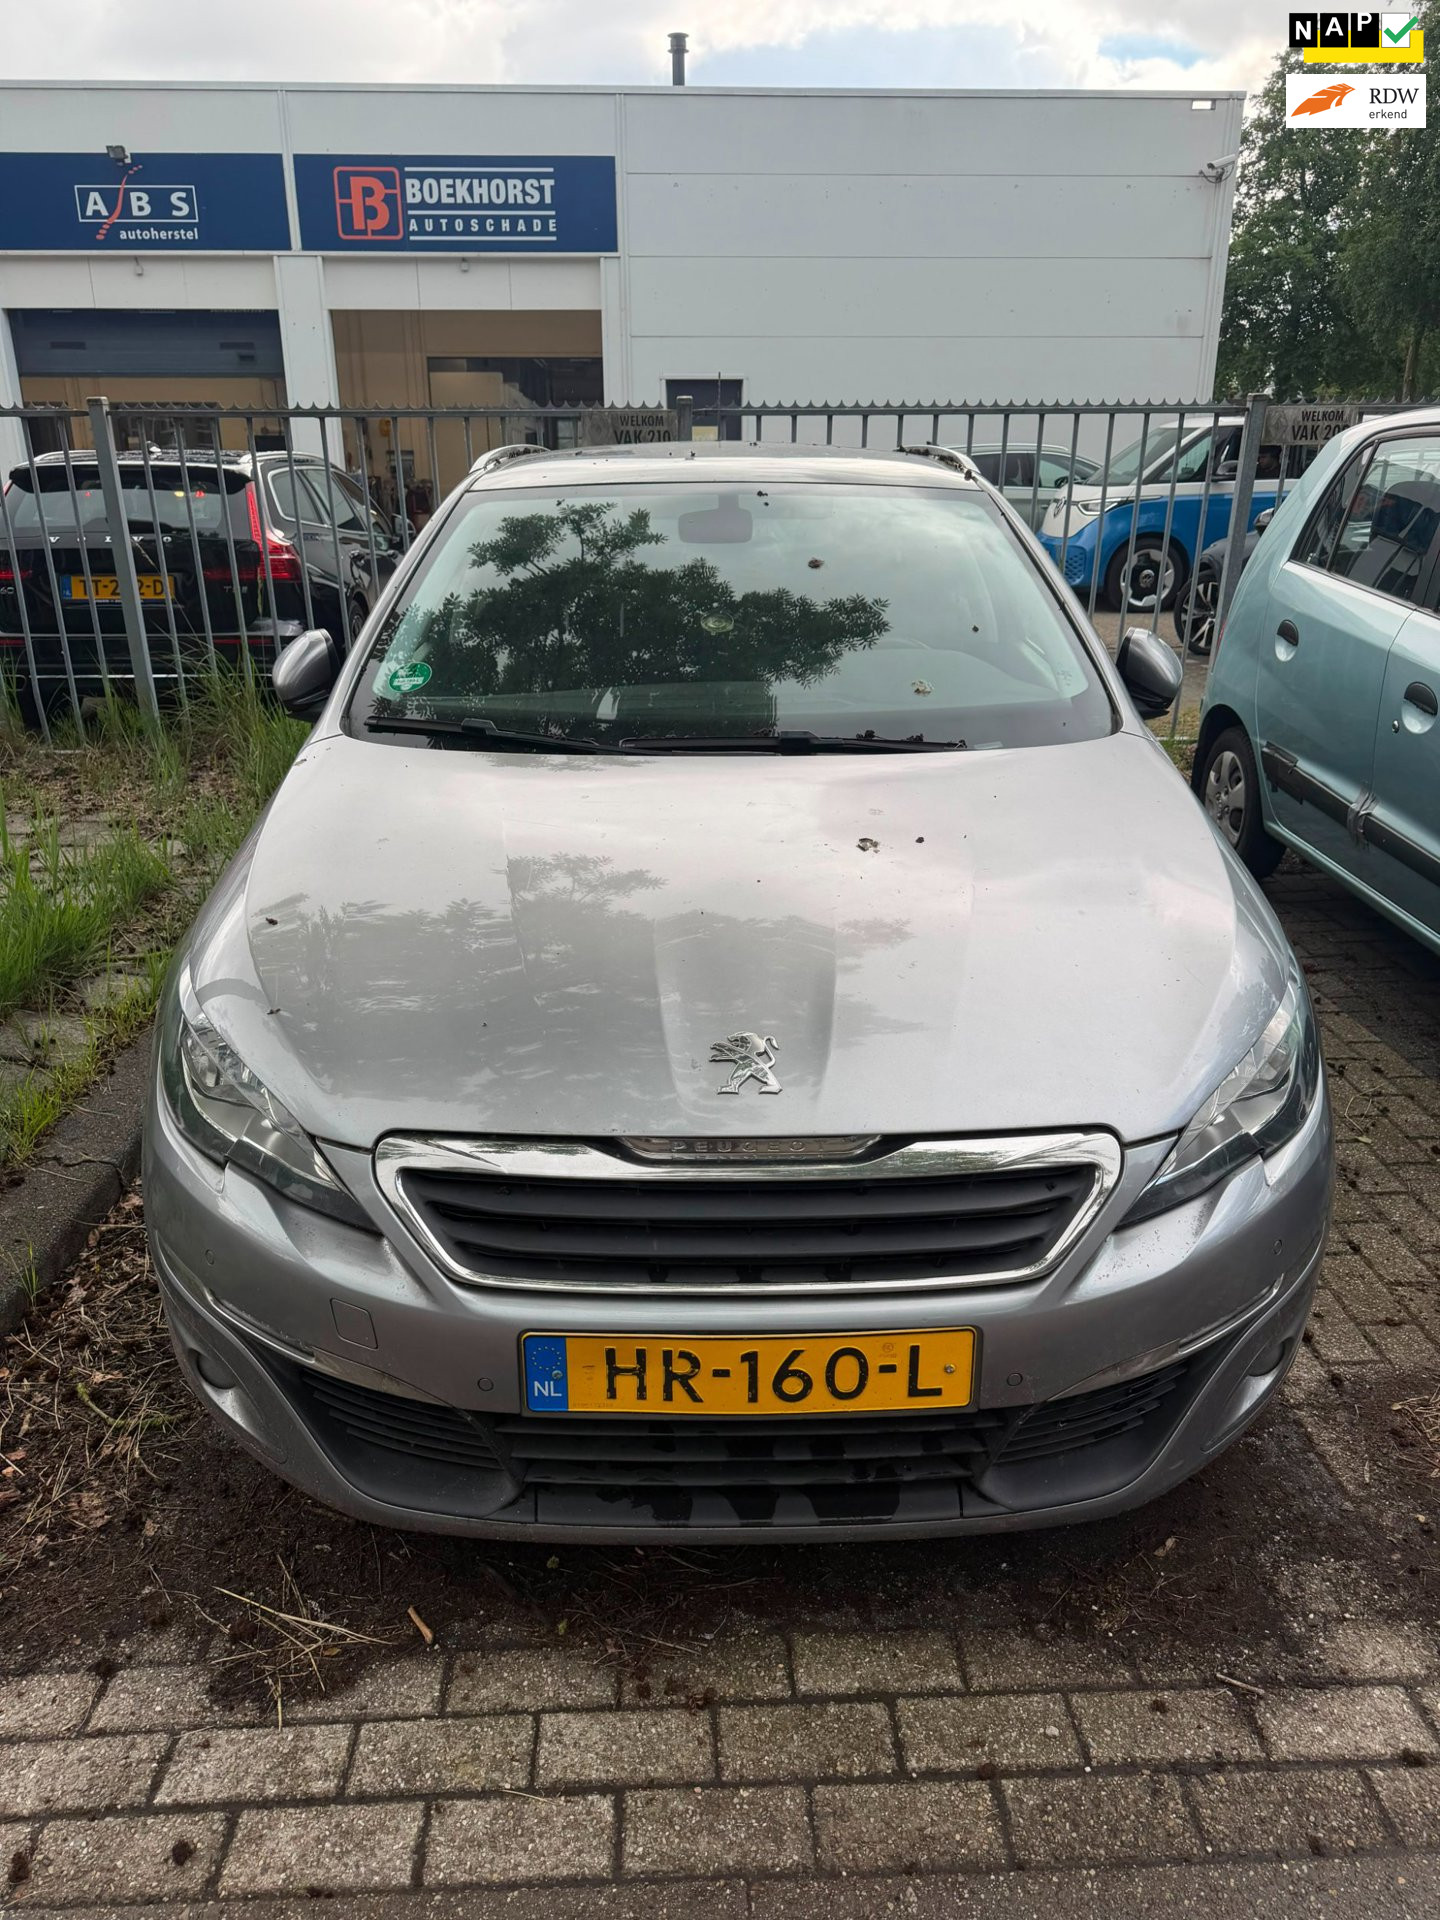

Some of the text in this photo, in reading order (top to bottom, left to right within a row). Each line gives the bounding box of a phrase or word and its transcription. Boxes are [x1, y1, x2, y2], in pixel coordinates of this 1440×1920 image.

[404, 177, 556, 205] BOEKHORST
[119, 227, 199, 240] autoherstel
[408, 218, 557, 233] AUTOSCHADE
[619, 415, 664, 427] WELKOM
[1301, 409, 1344, 422] WELKOM
[614, 430, 672, 444] VAK 210
[1291, 424, 1320, 441] VAK
[79, 579, 165, 596] TT-22-D
[604, 1344, 944, 1404] HR-160-L
[533, 1380, 562, 1398] NL
